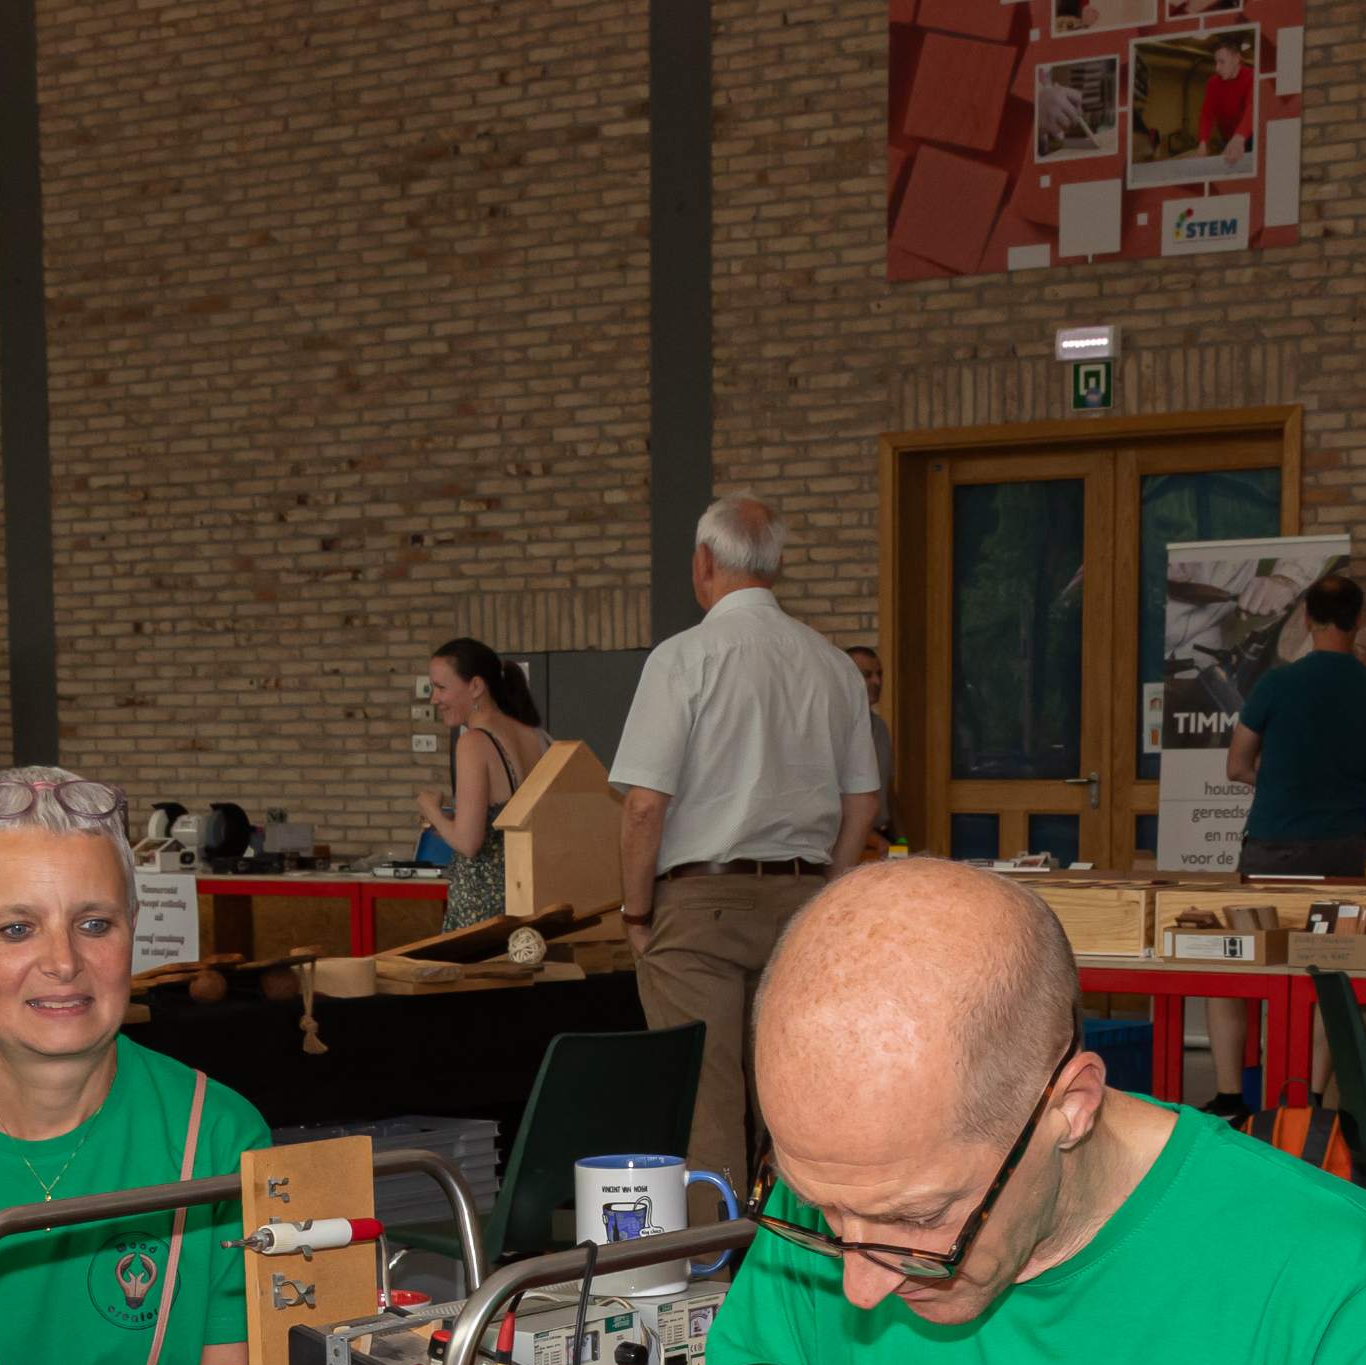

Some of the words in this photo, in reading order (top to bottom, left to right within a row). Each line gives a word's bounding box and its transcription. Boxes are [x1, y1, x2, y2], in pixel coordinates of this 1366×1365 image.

[1186, 218, 1237, 238] STEM
[1191, 805, 1249, 823] gereeds
[1205, 830, 1221, 841] en
[1225, 830, 1244, 841] ma
[1181, 854, 1212, 865] voor
[1217, 851, 1234, 865] de
[116, 1242, 158, 1254] Wood
